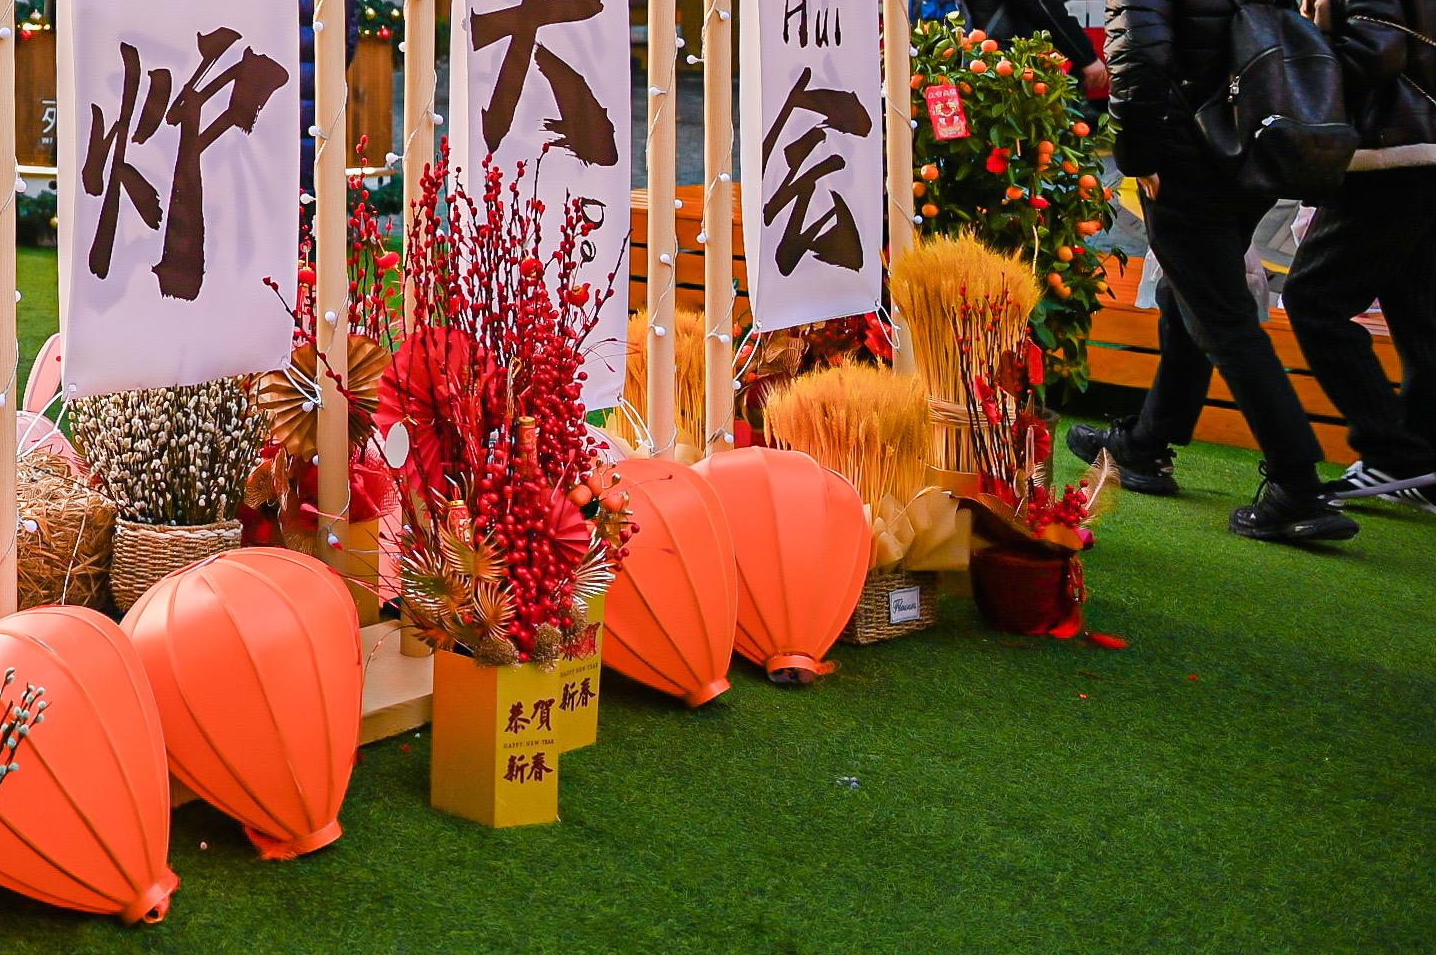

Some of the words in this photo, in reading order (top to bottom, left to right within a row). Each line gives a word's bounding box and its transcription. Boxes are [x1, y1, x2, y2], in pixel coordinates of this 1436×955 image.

[81, 25, 290, 302] 炉
[762, 66, 873, 277] 会
[559, 677, 597, 712] 新春
[503, 698, 556, 734] 恭賀
[503, 741, 523, 749] HAPPY
[526, 739, 540, 747] NEW
[503, 751, 555, 784] 新春
